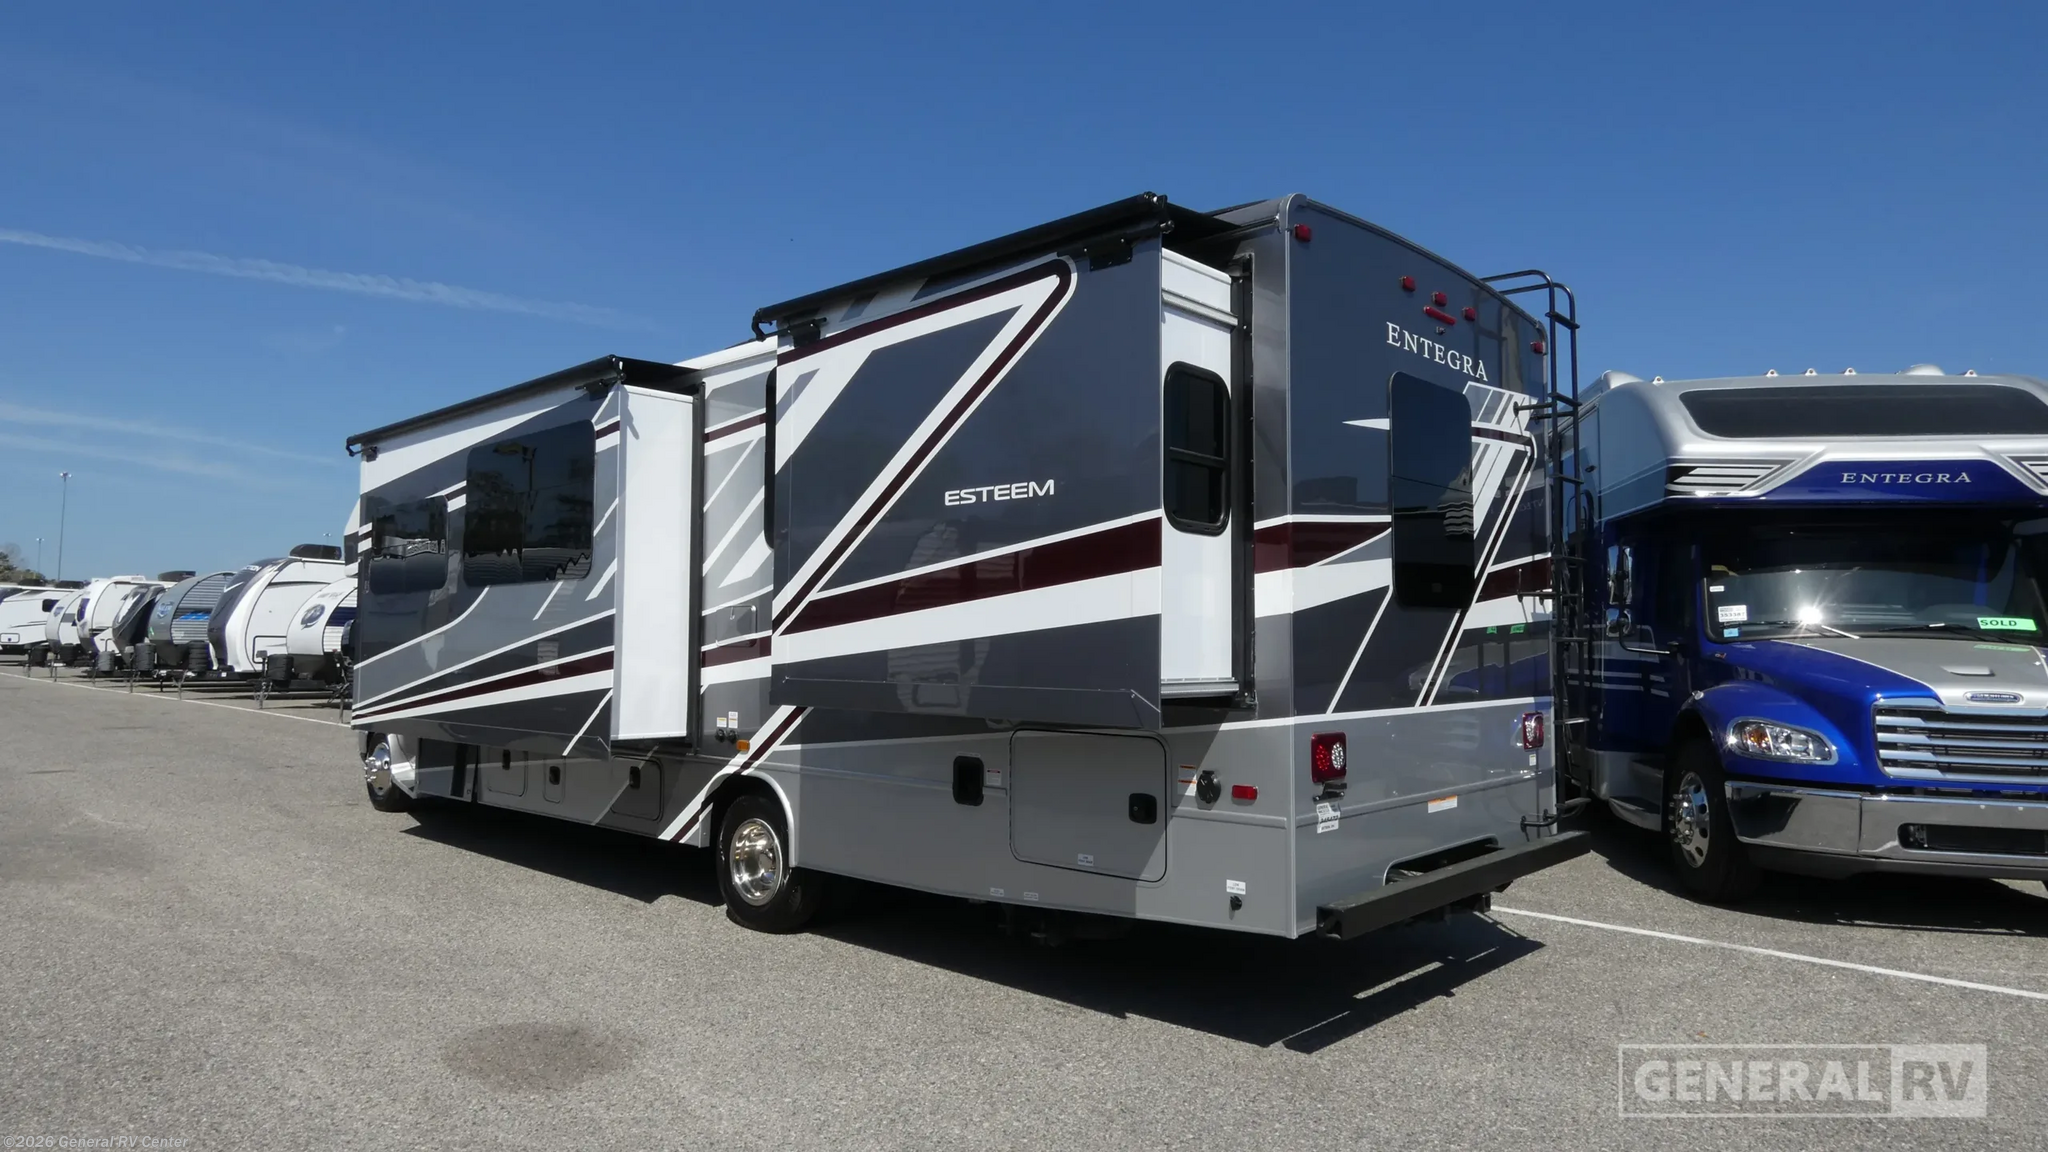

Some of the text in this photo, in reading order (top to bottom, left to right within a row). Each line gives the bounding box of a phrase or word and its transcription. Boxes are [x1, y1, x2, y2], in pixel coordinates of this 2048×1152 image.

[1386, 321, 1489, 382] ENTEGRA
[1841, 472, 1972, 484] ENTEGRA
[944, 478, 1055, 506] ESTEEM
[1980, 619, 2017, 627] SOLD
